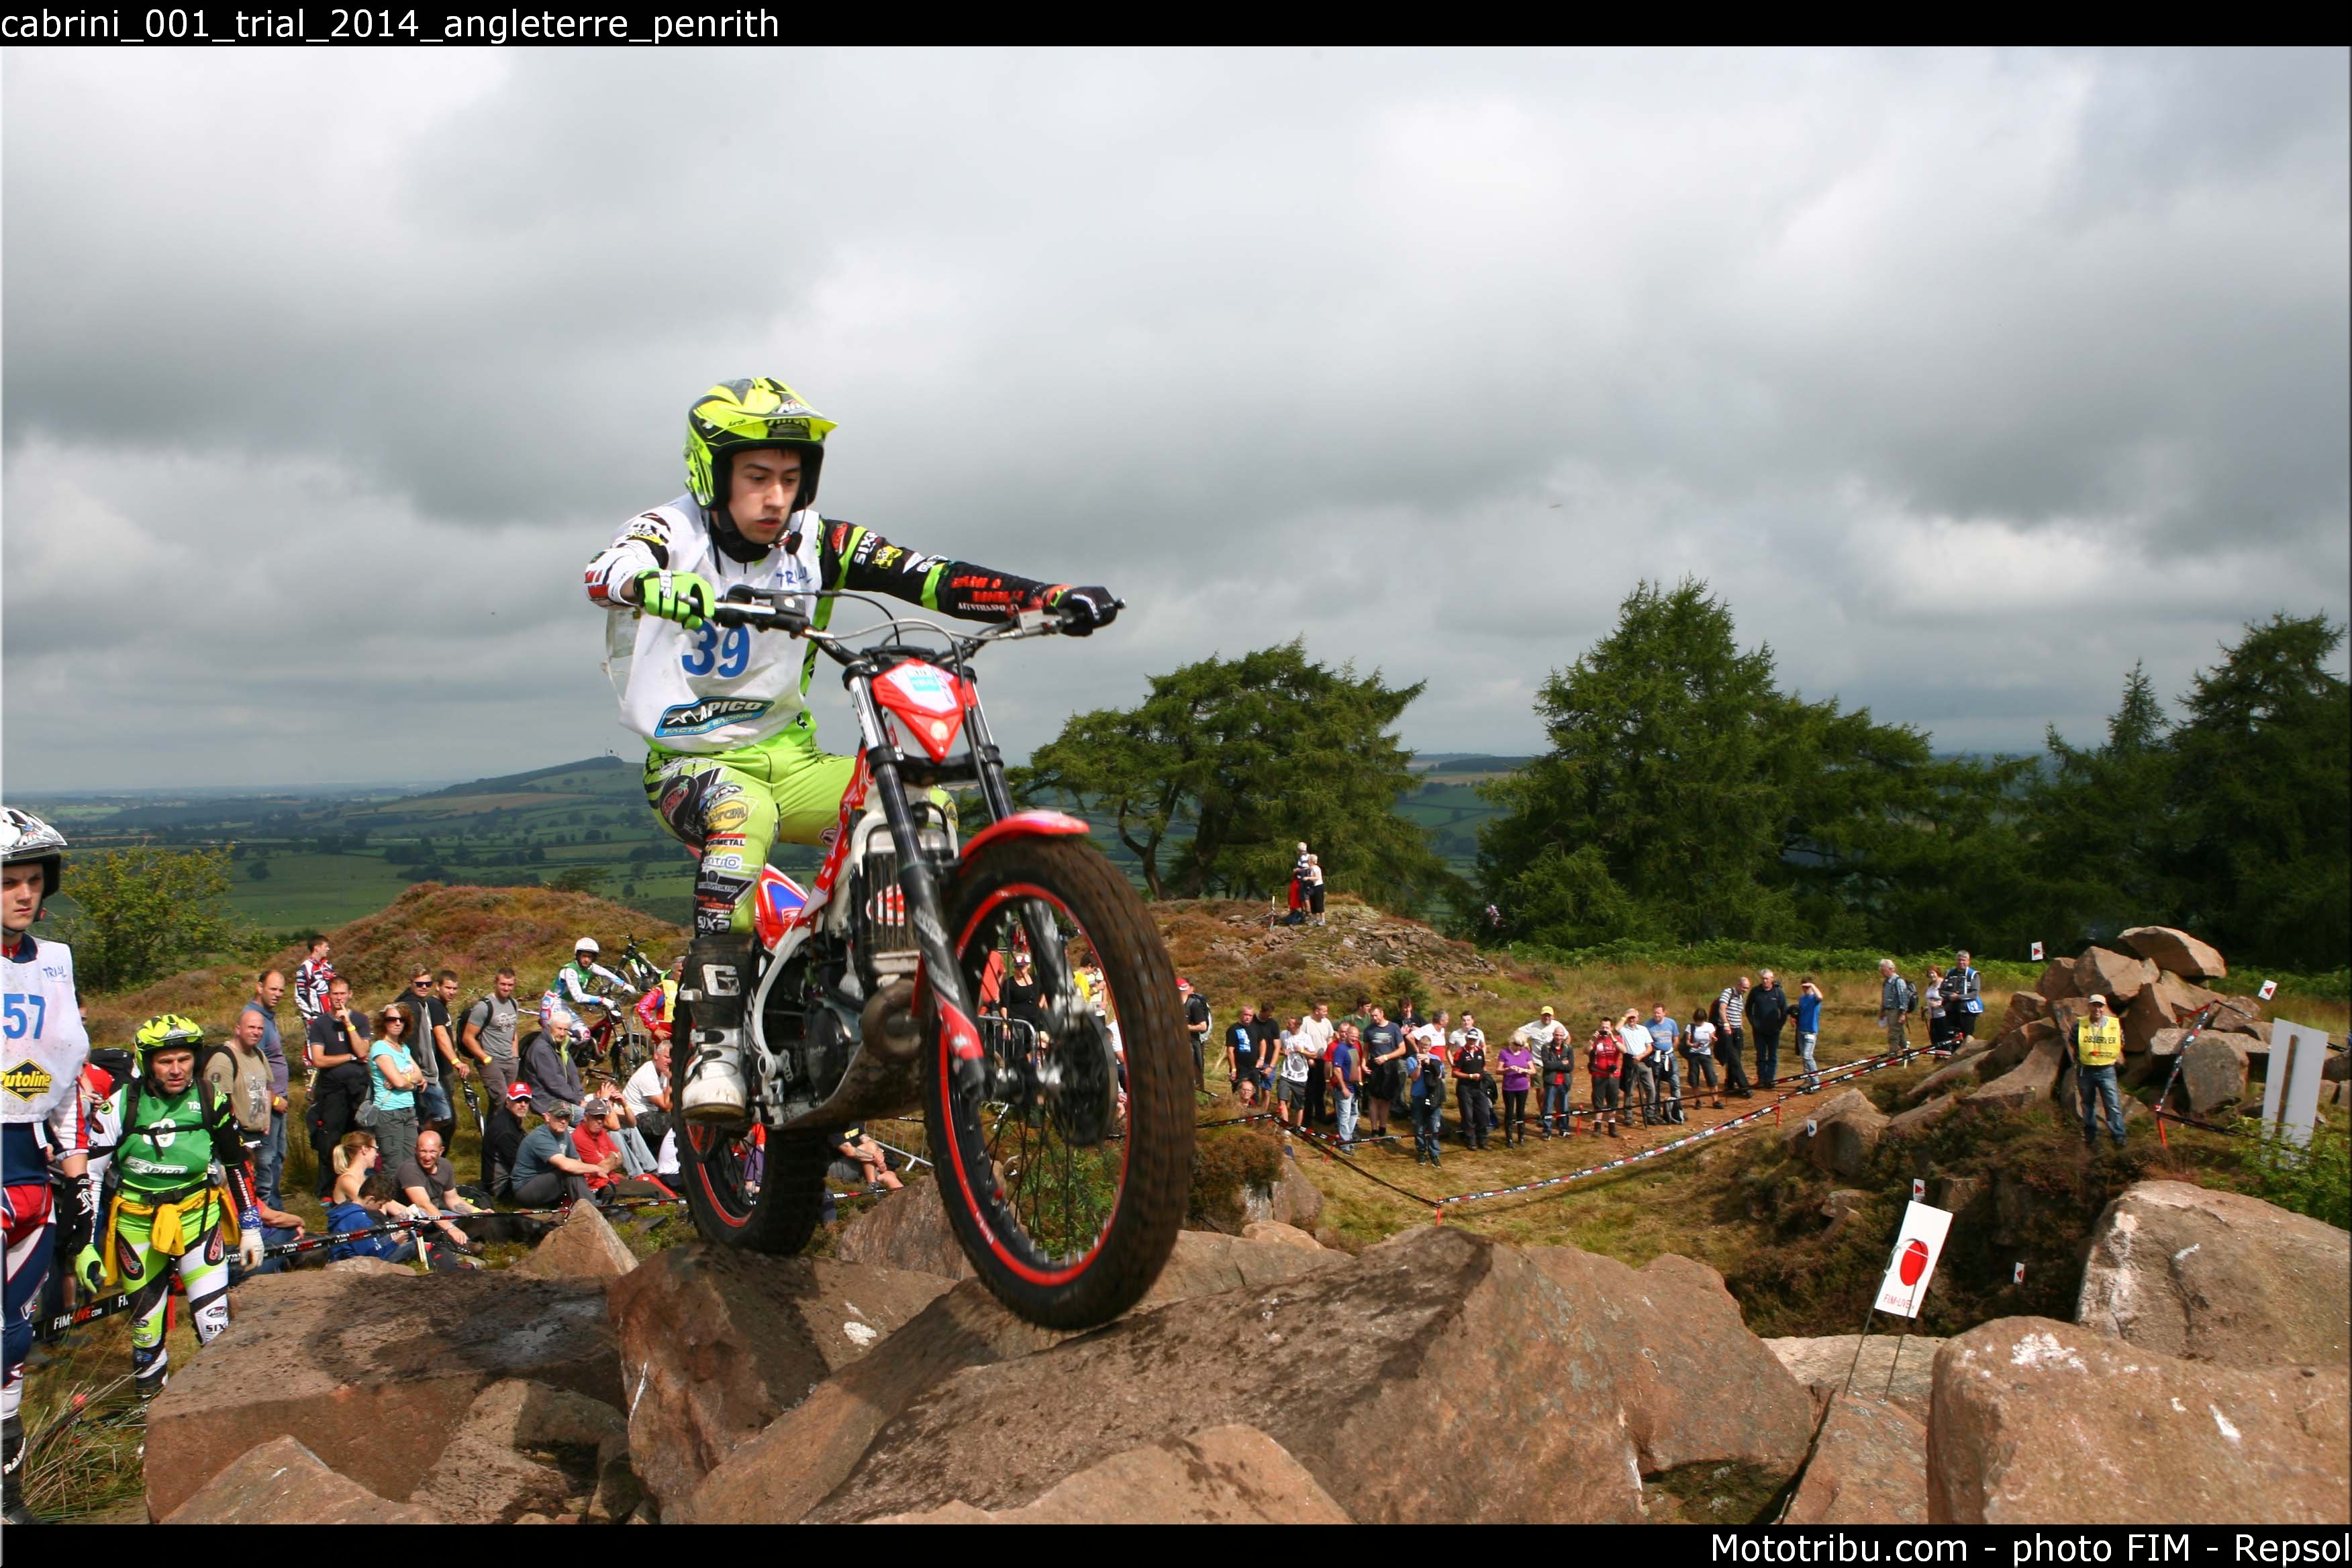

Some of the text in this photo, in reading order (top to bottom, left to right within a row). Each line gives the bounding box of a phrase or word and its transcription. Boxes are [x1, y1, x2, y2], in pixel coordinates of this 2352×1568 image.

[682, 620, 750, 678] 39
[697, 701, 763, 723] APICO
[713, 713, 752, 726] RACING
[3, 993, 46, 1040] 57
